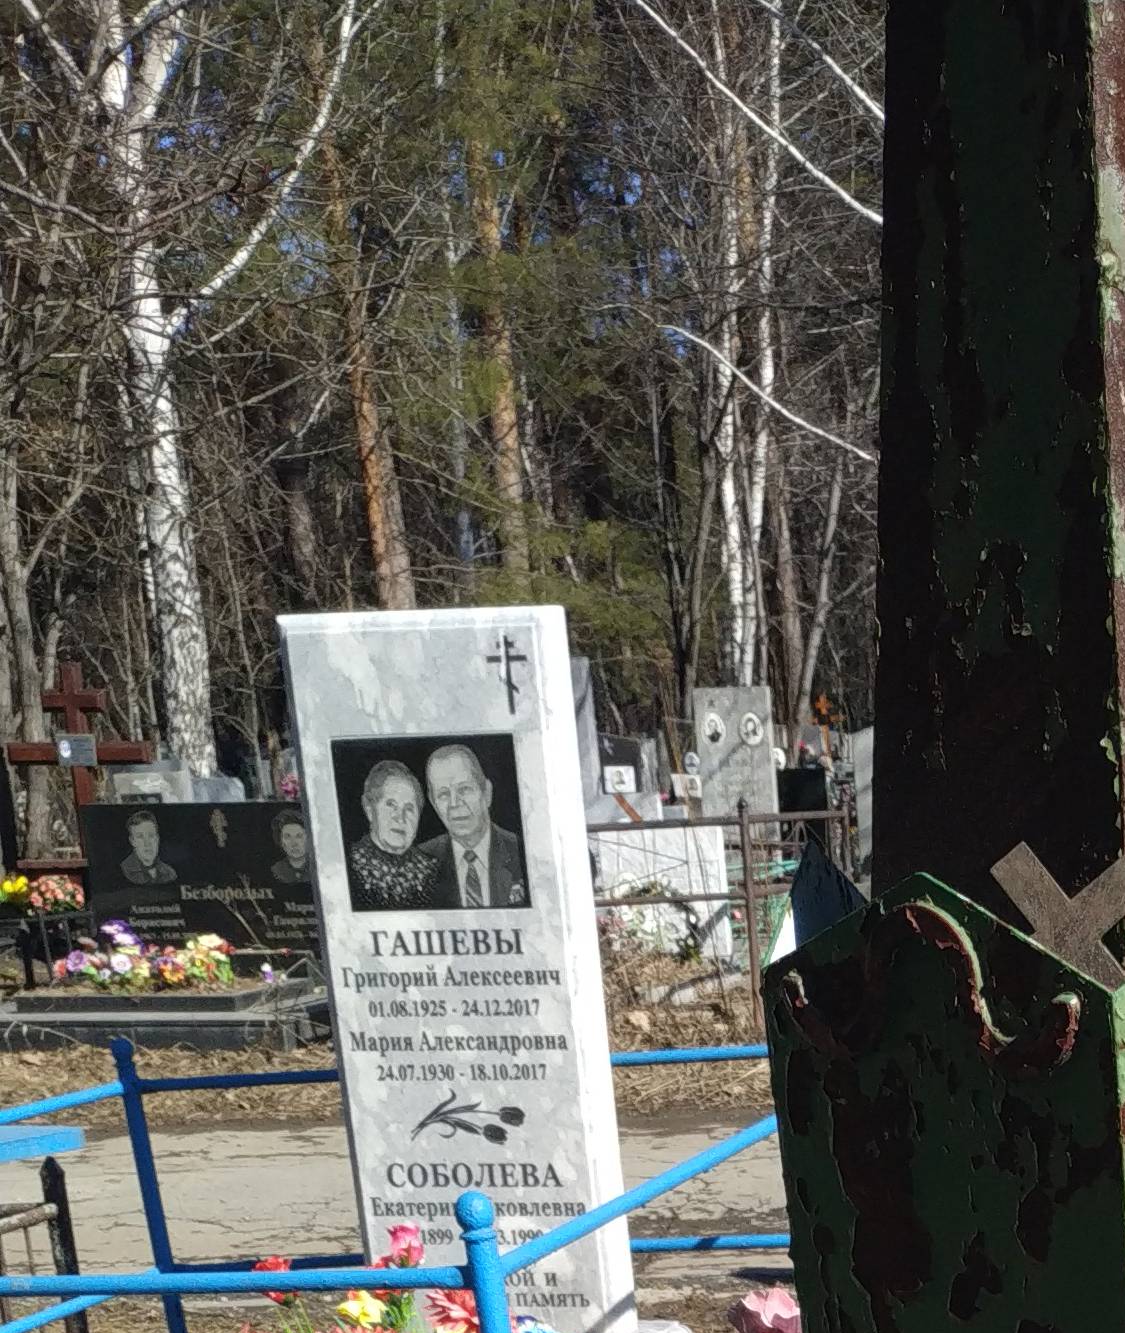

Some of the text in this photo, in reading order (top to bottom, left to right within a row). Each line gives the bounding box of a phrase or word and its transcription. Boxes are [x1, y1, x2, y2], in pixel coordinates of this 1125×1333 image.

[370, 929, 524, 956] ГАШЕВЫ
[342, 964, 561, 993] Григорий Алексеевич
[368, 1000, 447, 1018] 01.08.1925
[463, 999, 540, 1017] 24.12.2017
[350, 1031, 568, 1058] Мария Александровна
[377, 1064, 454, 1081] 24.07.1930
[470, 1063, 547, 1081] 18.10.2017
[387, 1162, 563, 1188] СОБОЛЕВА
[371, 1197, 586, 1221] Екатери ковлевна
[544, 1272, 558, 1287] И
[515, 1293, 590, 1308] ПАМЯТЬ
